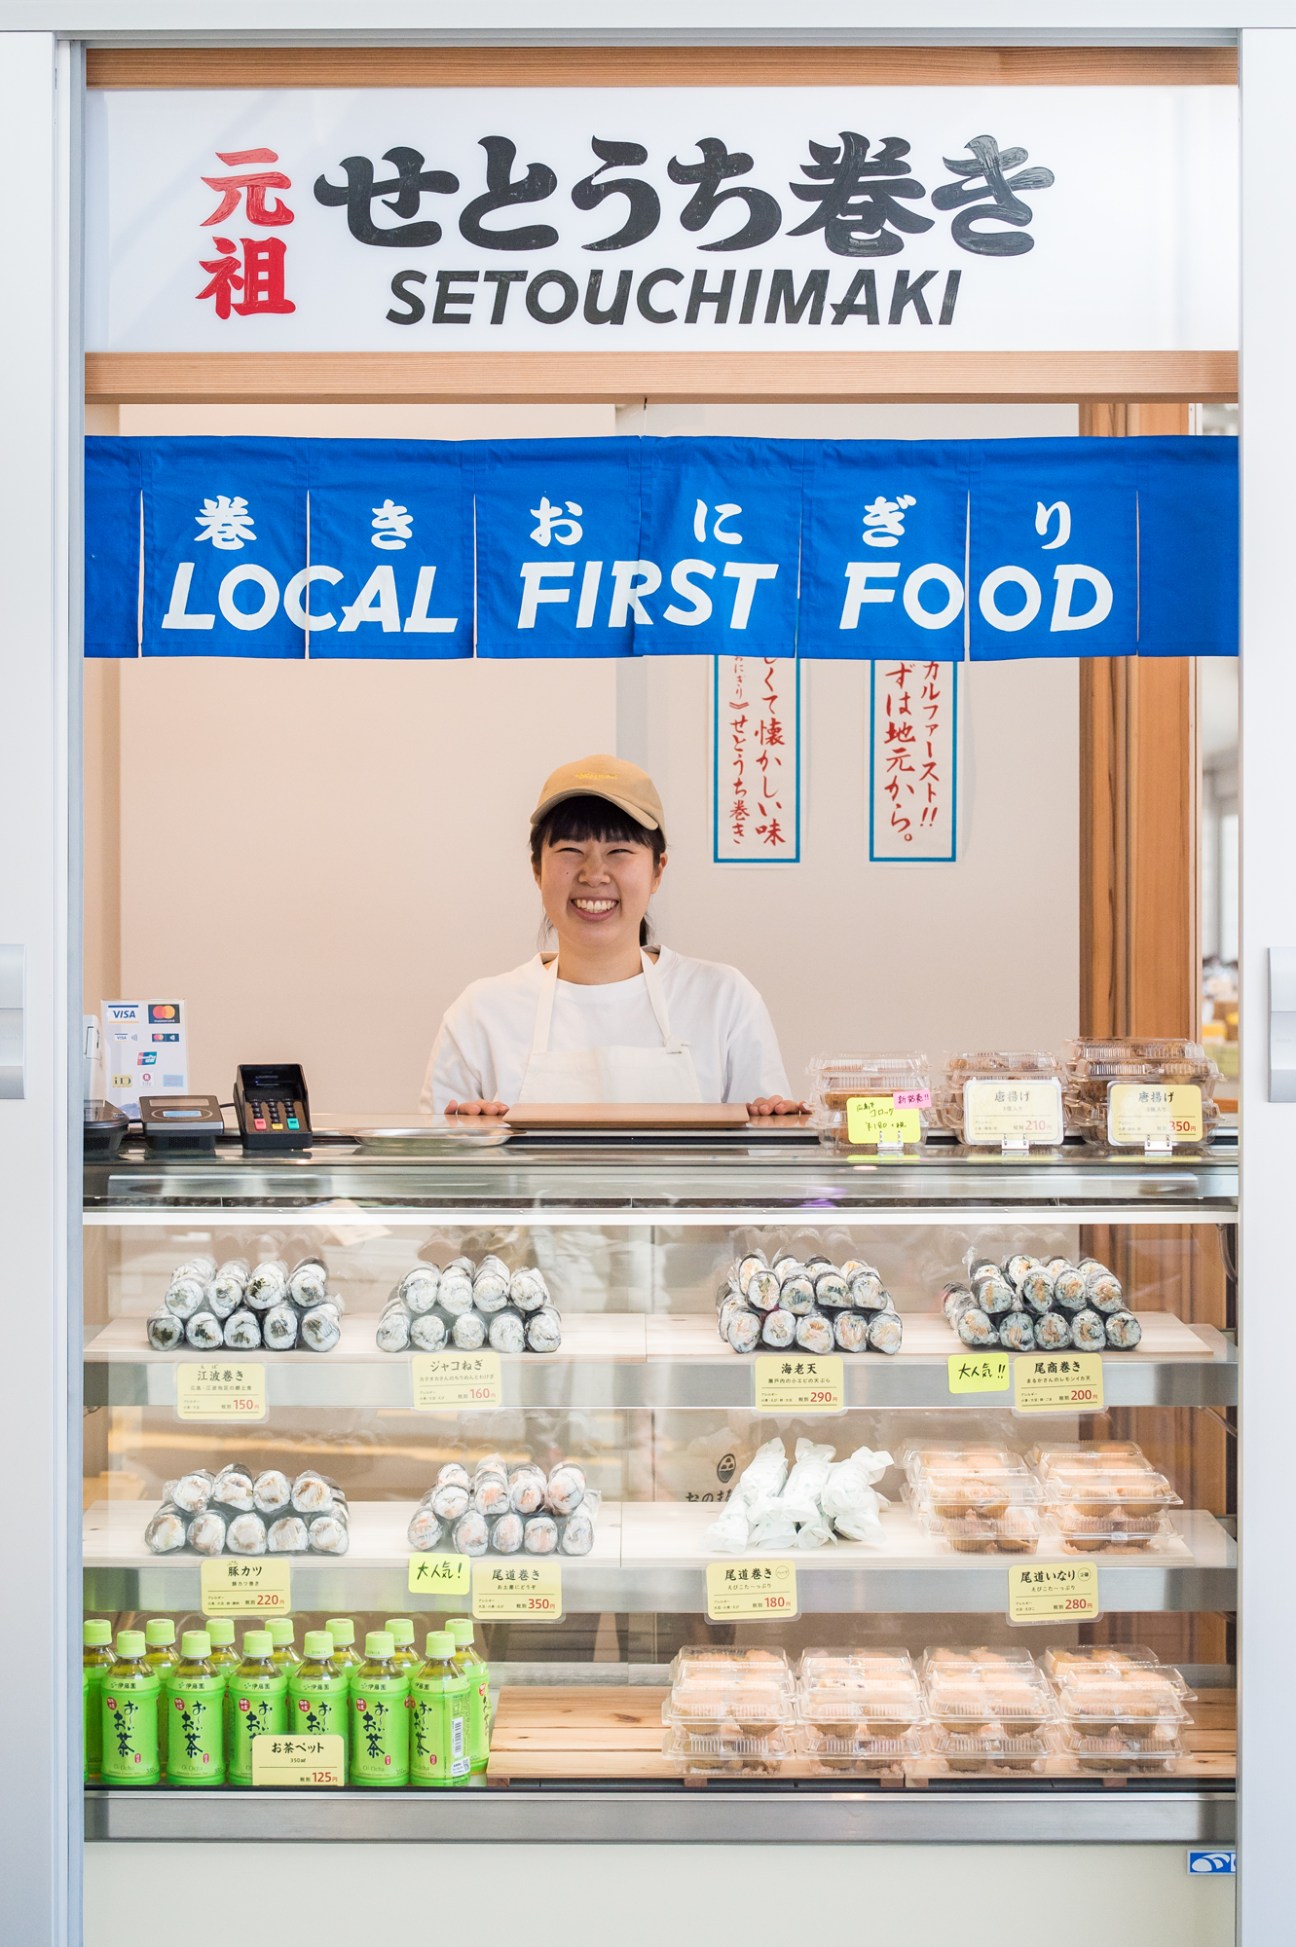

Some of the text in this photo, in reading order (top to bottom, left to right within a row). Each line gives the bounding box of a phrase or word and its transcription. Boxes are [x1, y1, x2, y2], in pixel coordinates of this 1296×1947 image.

[314, 131, 1055, 258] せとうち巻き
[197, 148, 295, 320] 元祖
[386, 268, 961, 326] SETOUCHIMAKI
[162, 560, 1114, 634] LOCAL FIRST FOOD
[113, 1010, 136, 1018] VISA
[995, 1090, 1030, 1103] 唐揚げ
[1139, 1091, 1175, 1103] 唐揚げ
[430, 1359, 483, 1373] ジャコねぎ
[781, 1362, 818, 1375] 海老天
[1034, 1360, 1081, 1375] 尾商巻き
[197, 1370, 244, 1382] 江波巻き
[227, 1566, 263, 1577] 豚カツ
[491, 1568, 541, 1581] 尾道巻き
[724, 1567, 772, 1581] 尾道巻き
[1020, 1569, 1076, 1584] 尾道いなり
[114, 1710, 135, 1758] お茶
[182, 1710, 204, 1758] お茶
[362, 1710, 386, 1758] お茶
[271, 1742, 325, 1754] お茶ペット
